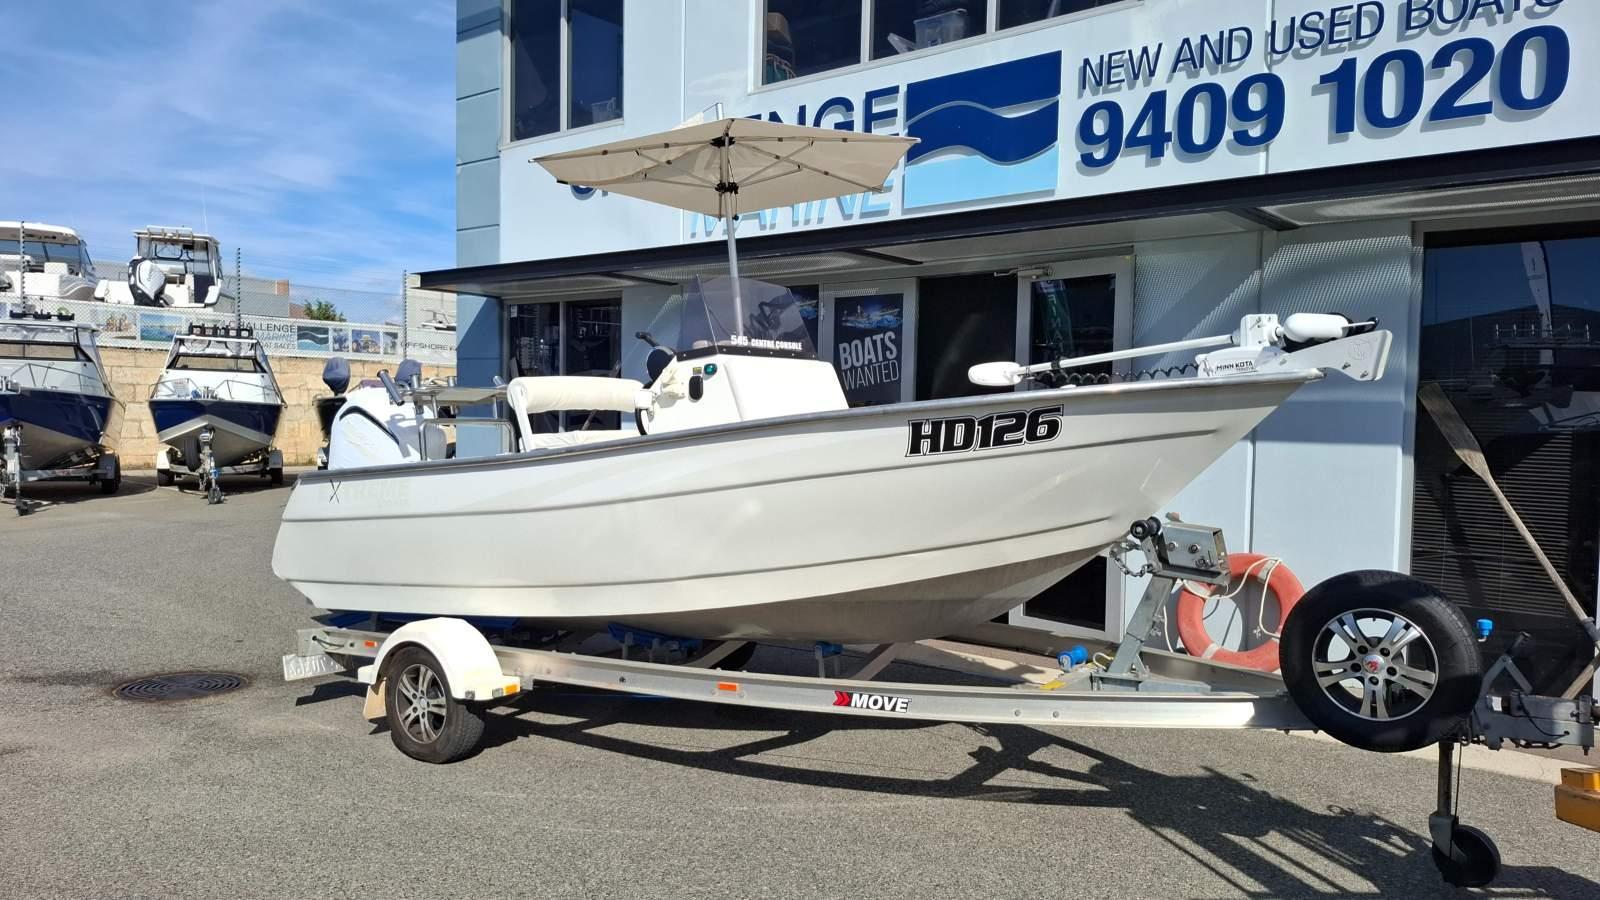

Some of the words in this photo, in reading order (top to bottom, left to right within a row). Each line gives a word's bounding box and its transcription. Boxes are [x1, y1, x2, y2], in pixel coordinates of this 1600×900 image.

[1081, 42, 1163, 90] NEW
[1171, 26, 1253, 74] AND
[1269, 0, 1385, 55] USED
[1079, 72, 1286, 168] 9409
[1319, 25, 1571, 135] 1020
[751, 338, 775, 348] CENTRE
[775, 341, 803, 351] CONSOLE
[838, 331, 898, 370] BOATS
[842, 359, 900, 391] WANTED
[905, 404, 1064, 457] HD126
[850, 693, 909, 713] MOVE
